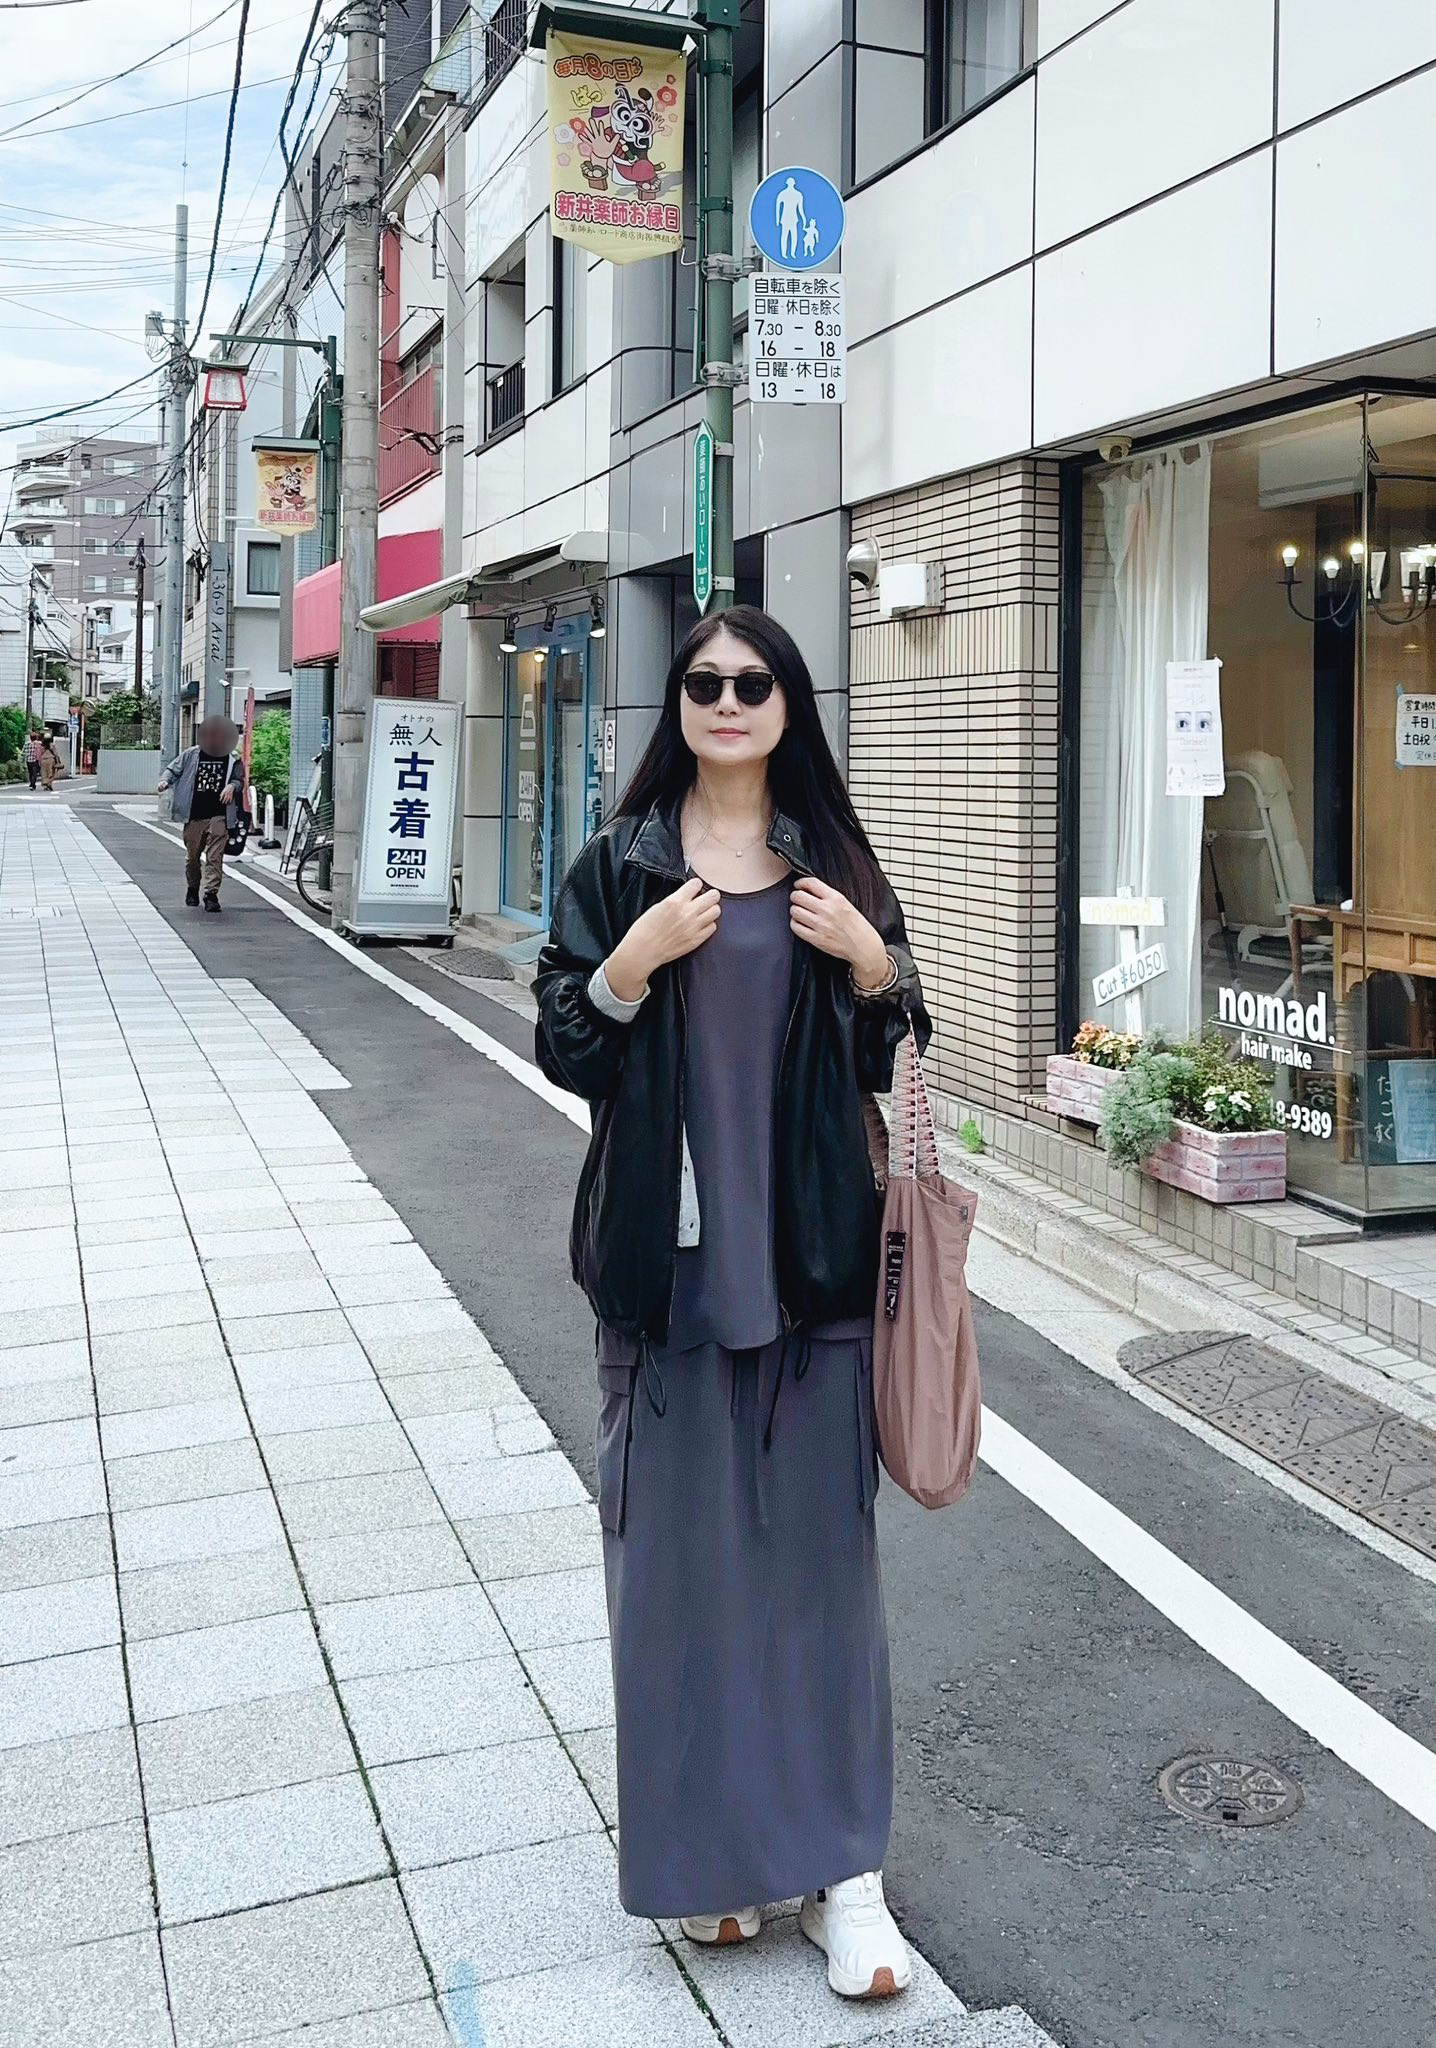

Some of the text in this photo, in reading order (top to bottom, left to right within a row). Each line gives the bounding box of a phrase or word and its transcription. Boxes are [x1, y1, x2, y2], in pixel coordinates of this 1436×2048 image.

[554, 53, 643, 82] 毎月8の日は
[555, 190, 680, 233] 新井薬師お縁日
[754, 278, 840, 294] 自転車を除く
[754, 319, 783, 336] 7.30
[814, 320, 842, 337] 8.30
[761, 340, 777, 356] 16
[820, 341, 836, 357] 18
[756, 362, 841, 378] 日曜・休日は
[761, 382, 778, 398] 13
[820, 383, 836, 399] 18
[211, 568, 226, 664] 1-36-9 Arai
[400, 714, 435, 723] オトナの
[1411, 716, 1429, 728] 平日
[389, 723, 443, 747] 無人
[391, 850, 424, 865] 24H
[386, 867, 425, 879] OPEN
[1097, 951, 1162, 999] Cut ¥6050
[1240, 1031, 1312, 1070] hair make
